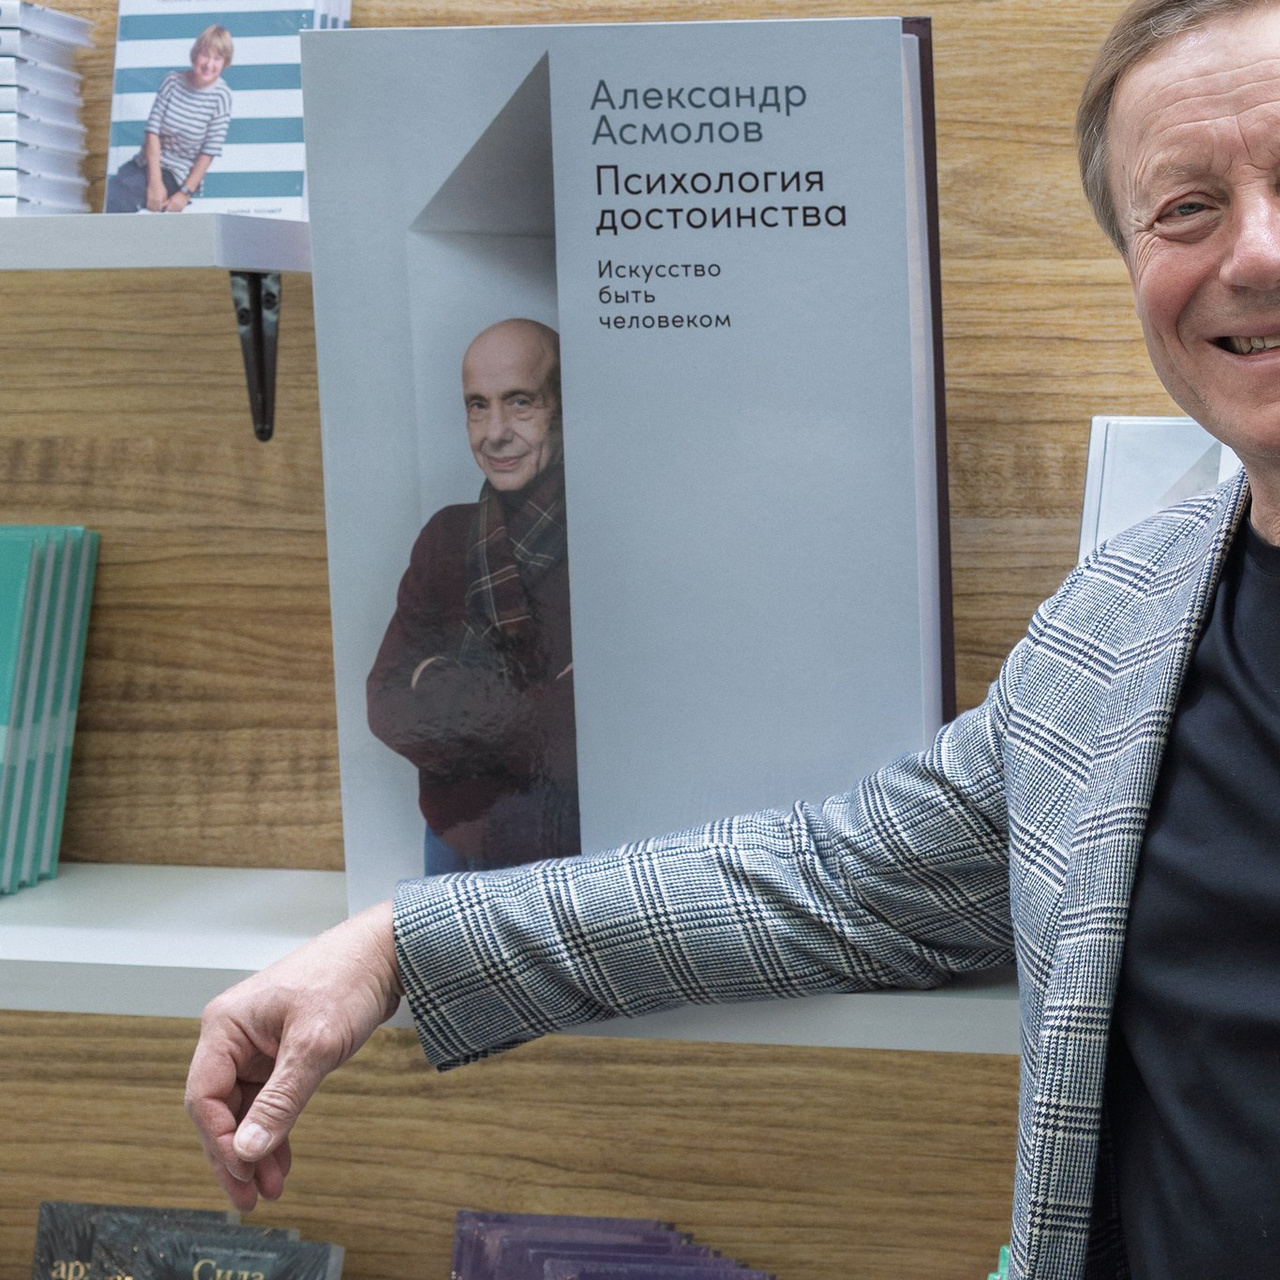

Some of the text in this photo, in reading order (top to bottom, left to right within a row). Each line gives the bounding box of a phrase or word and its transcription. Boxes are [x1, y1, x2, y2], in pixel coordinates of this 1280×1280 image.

[590, 80, 807, 115] Александр
[592, 115, 763, 145] Асмолов
[596, 165, 824, 195] Психология
[596, 205, 846, 236] достоинства
[598, 260, 721, 283] Искусство
[599, 286, 655, 304] быть
[599, 314, 731, 329] человеком
